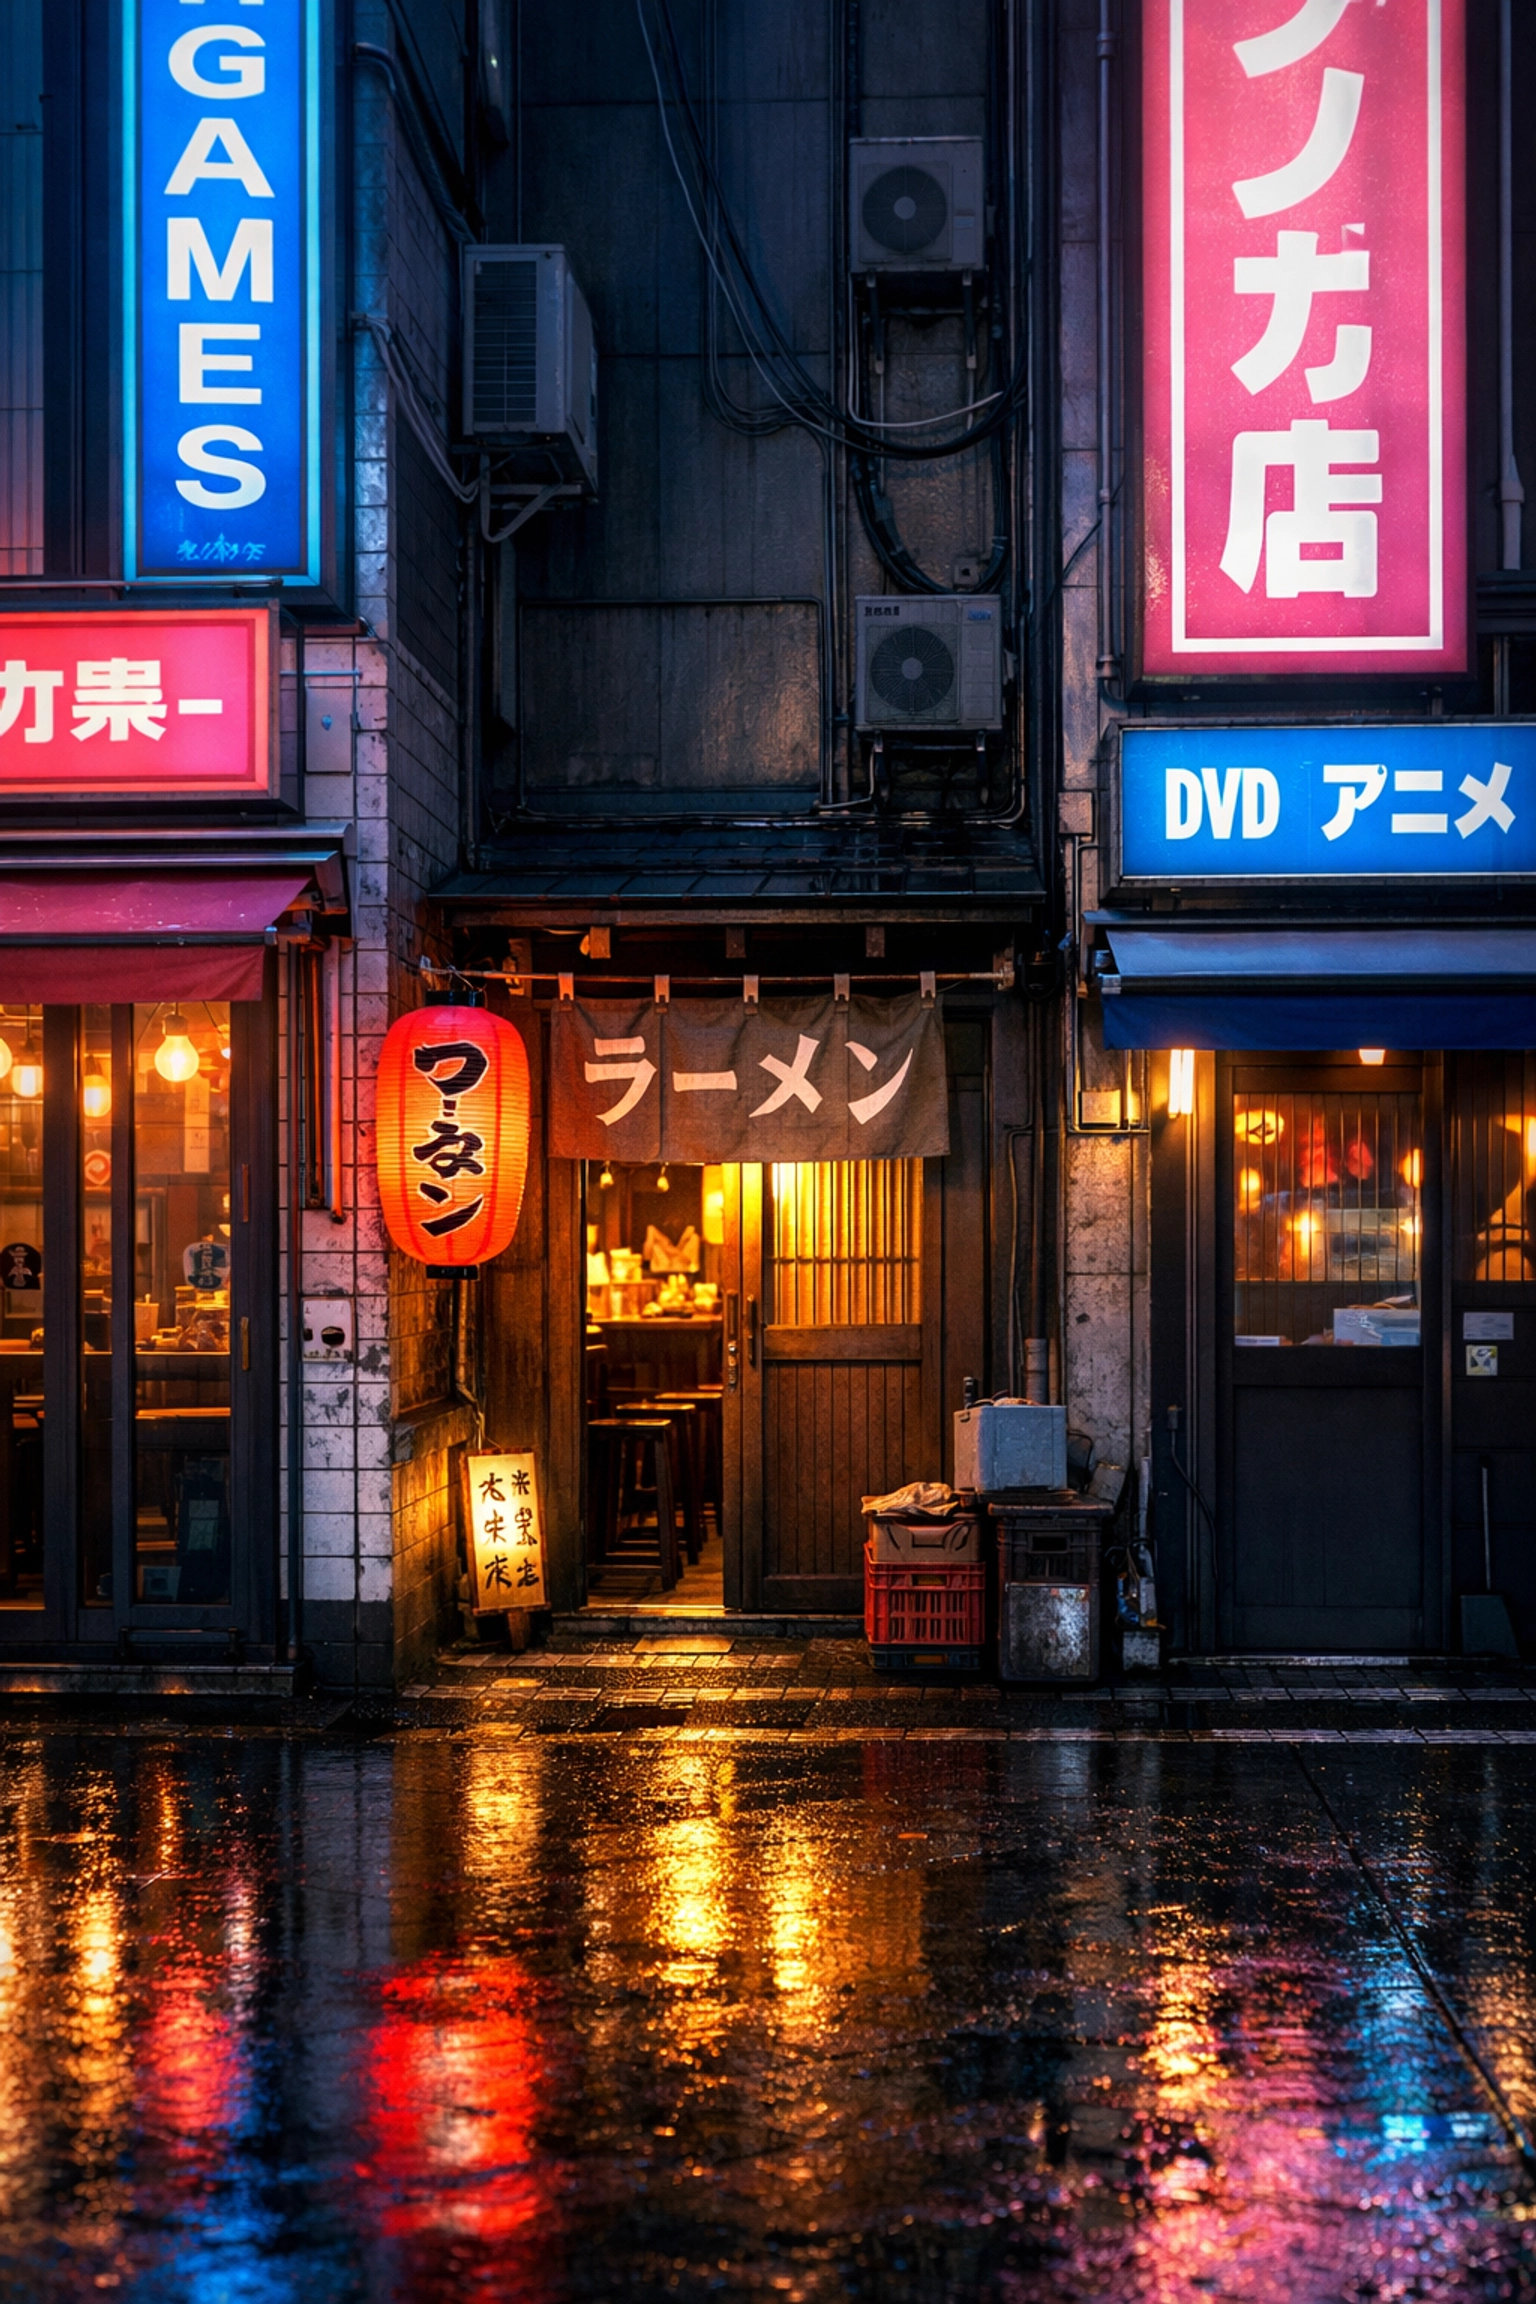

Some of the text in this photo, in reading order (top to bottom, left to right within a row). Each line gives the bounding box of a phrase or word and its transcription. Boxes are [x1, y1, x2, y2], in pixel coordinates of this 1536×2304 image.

[164, 0, 275, 509] GAMES
[1165, 762, 1516, 841] DVD アニメ
[584, 1033, 914, 1127] ラーメン
